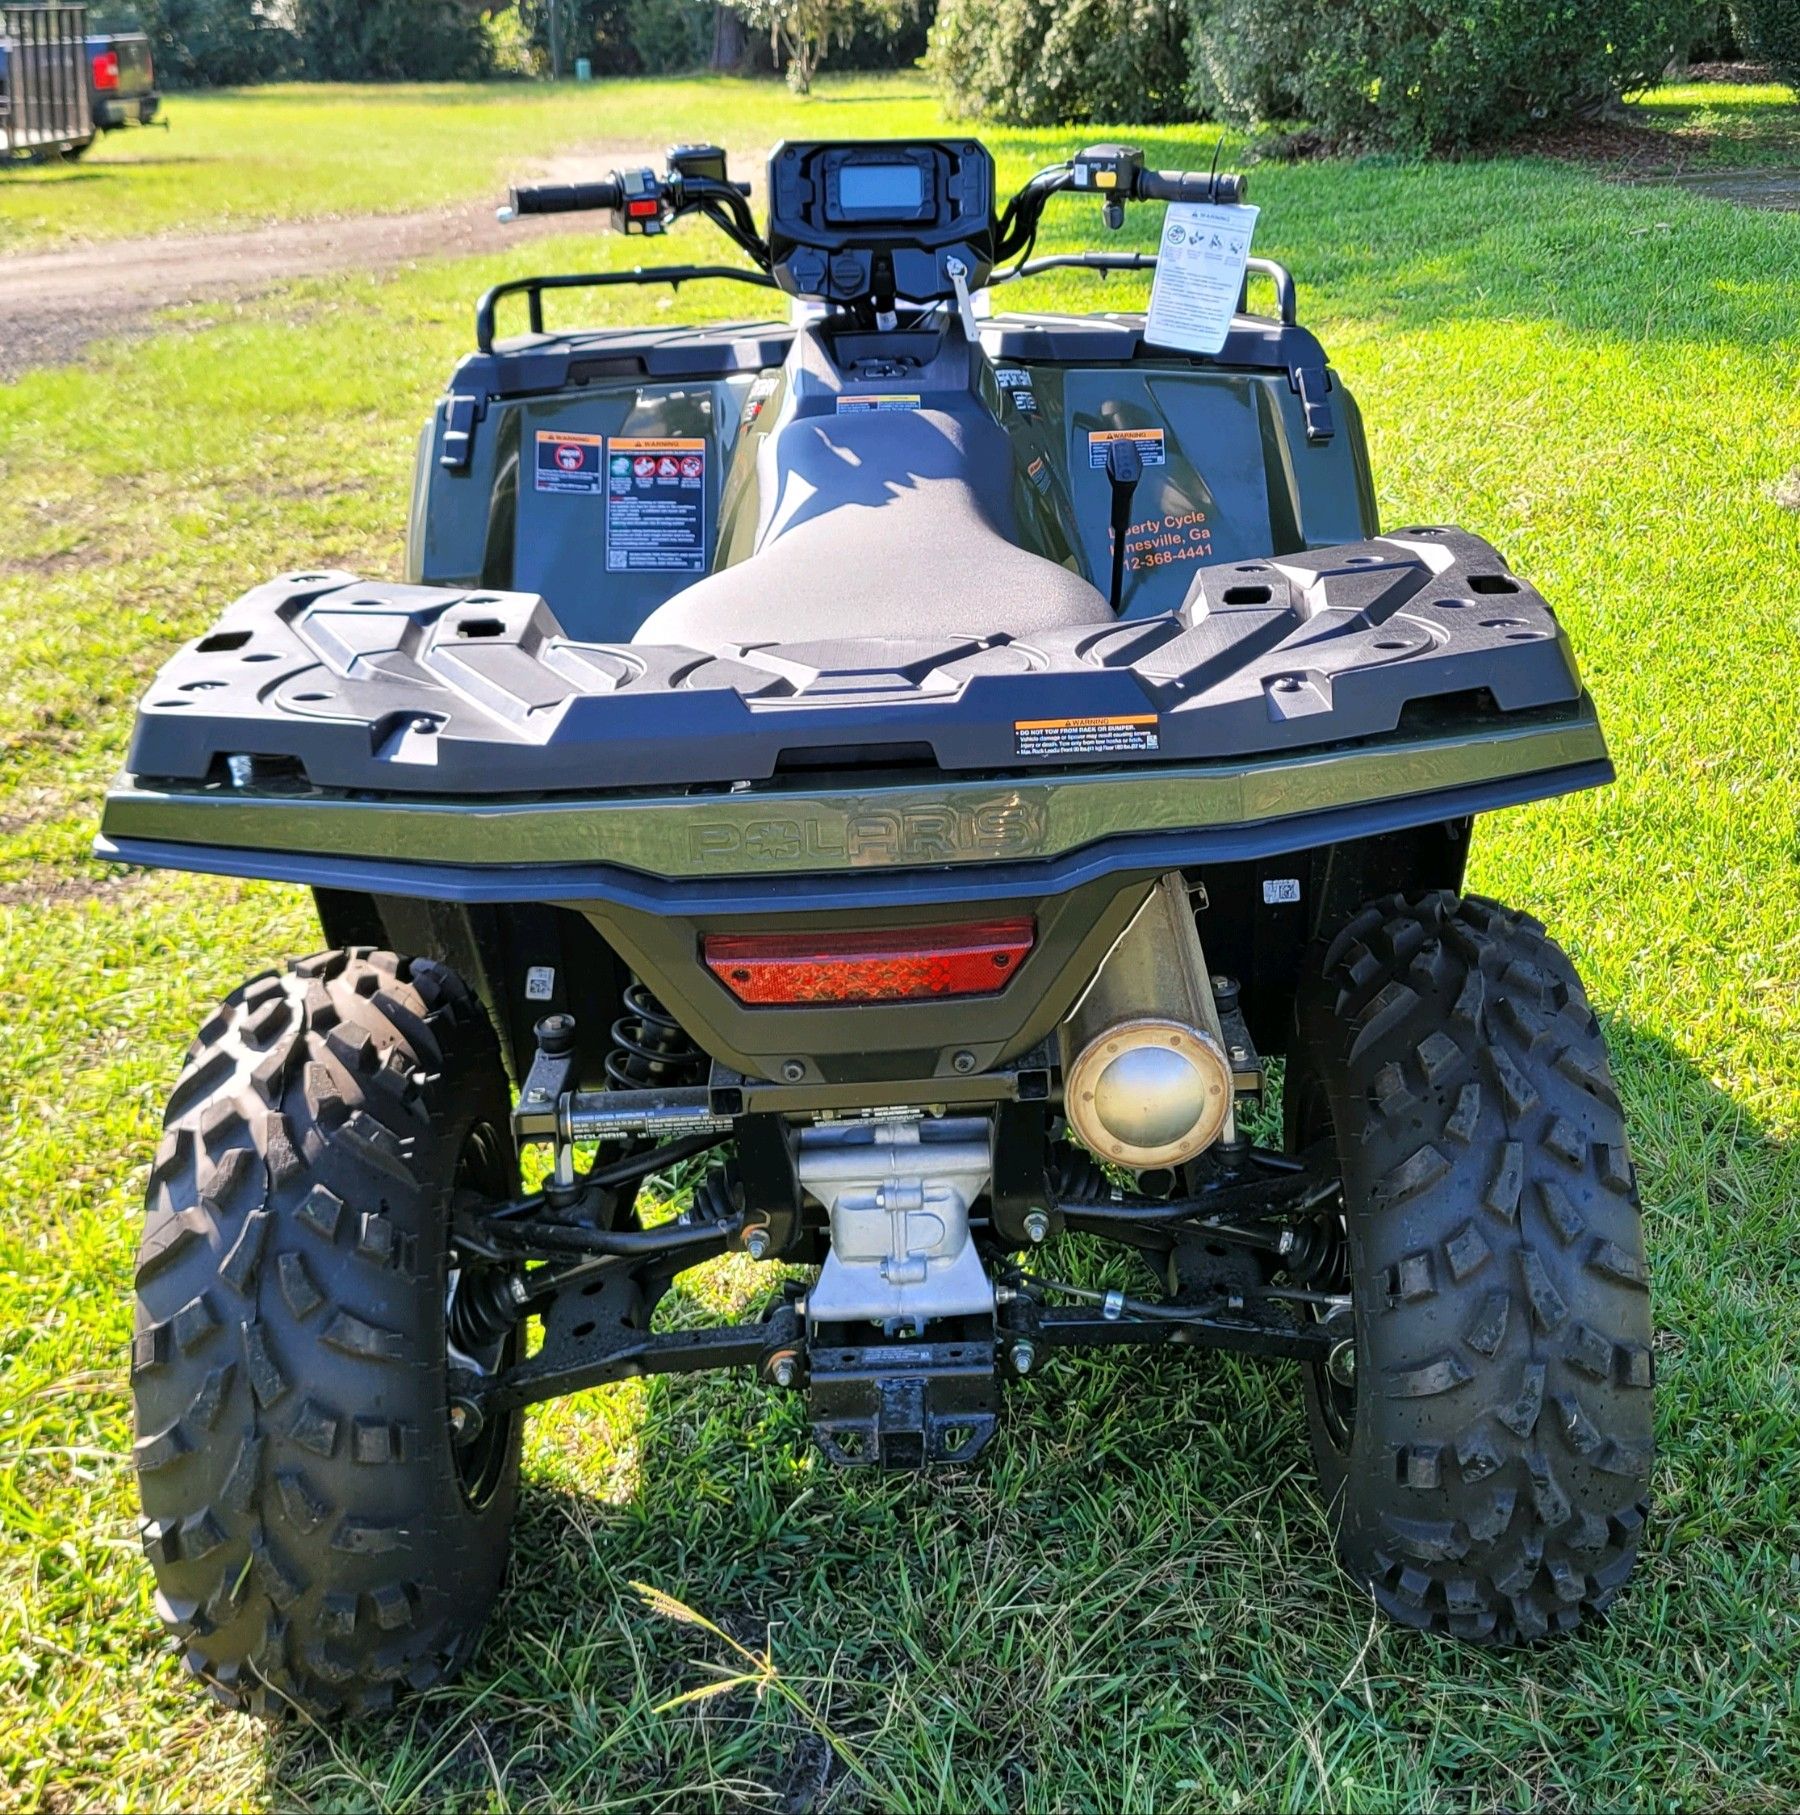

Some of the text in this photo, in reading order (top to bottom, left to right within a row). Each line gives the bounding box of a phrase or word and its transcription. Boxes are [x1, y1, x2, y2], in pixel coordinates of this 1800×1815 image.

[1164, 511, 1206, 529] Cycle
[1189, 528, 1211, 541] Ga
[1122, 543, 1213, 571] 12-368-4441
[1072, 719, 1109, 727] WARNING
[689, 805, 1032, 863] POLARIS
